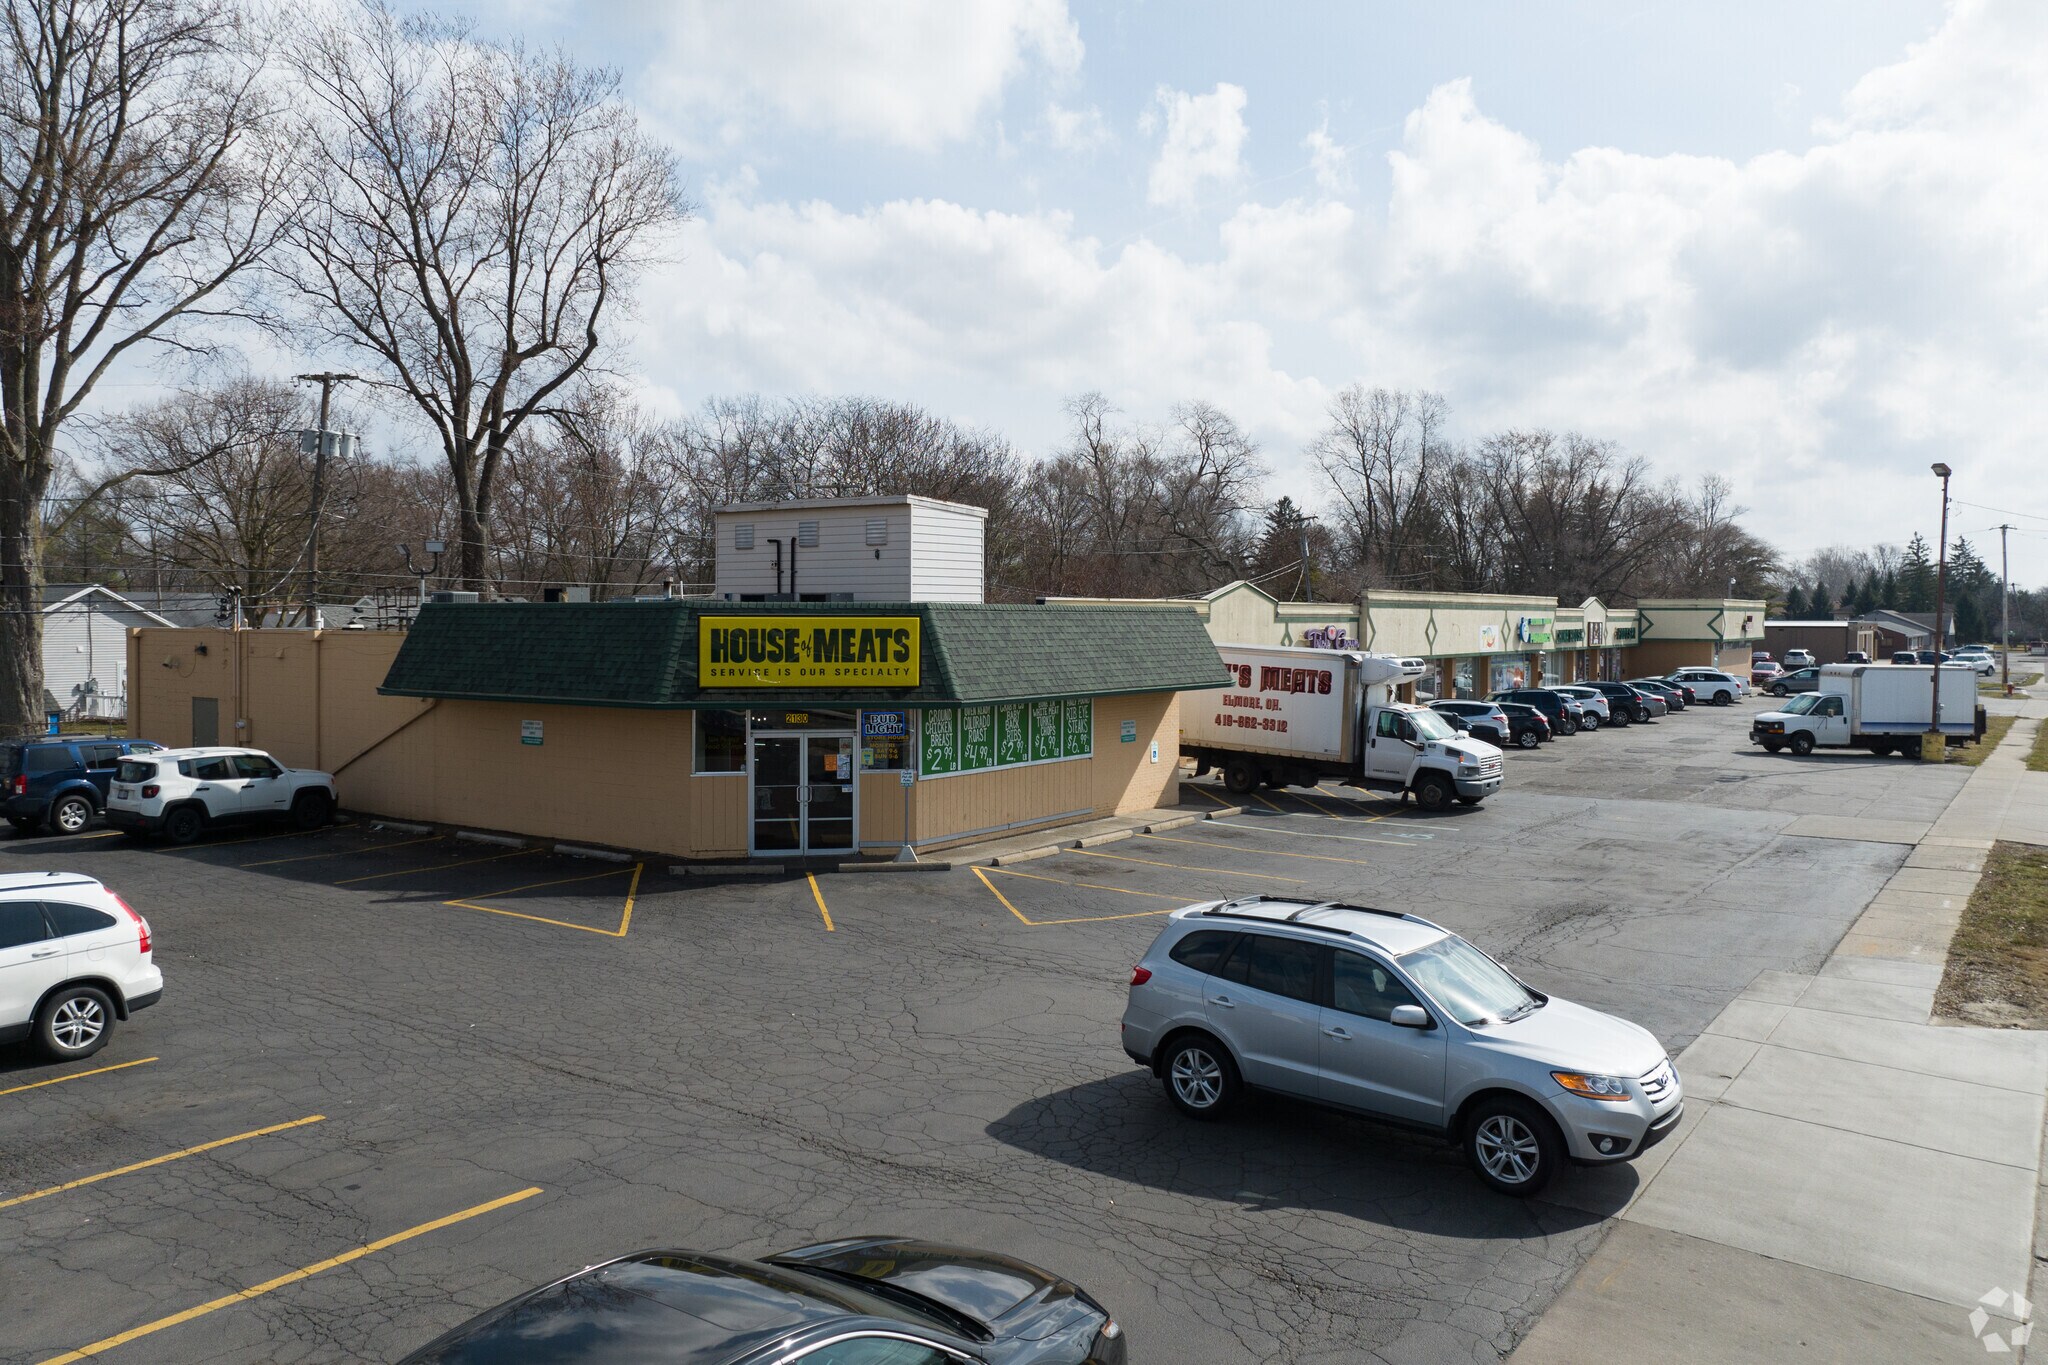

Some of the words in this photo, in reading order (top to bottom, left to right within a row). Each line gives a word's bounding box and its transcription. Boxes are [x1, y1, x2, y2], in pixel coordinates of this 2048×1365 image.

[711, 628, 800, 663] HOUSE
[801, 634, 812, 658] of
[813, 628, 910, 663] MEATS
[711, 668, 769, 676] SERVICE
[778, 668, 791, 676] IS
[800, 668, 826, 676] OUR
[835, 668, 910, 676] SPECIALTY
[1260, 666, 1332, 695] MEATS
[1222, 695, 1263, 710] ELMORE,
[1265, 698, 1282, 711] OH.
[928, 708, 952, 723] GROUND
[1006, 710, 1020, 720] BABY
[1033, 707, 1047, 717] WHITE
[1048, 706, 1059, 715] MEAT
[1066, 707, 1077, 720] RIB
[1079, 705, 1088, 718] EYE
[785, 713, 809, 724] 2130
[870, 714, 897, 725] BUD
[963, 714, 991, 731] COLORADO
[1005, 719, 1020, 731] BACK
[1036, 715, 1056, 728] TURKEY
[1215, 714, 1288, 733] 419-862-3312
[865, 723, 902, 734] LIGHT
[925, 720, 953, 735] CHICKEN
[1040, 726, 1056, 737] CHOPS
[1067, 719, 1088, 734] STEAKS
[930, 733, 953, 747] BREAST
[968, 728, 987, 743] ROAST
[1006, 729, 1021, 742] RIBS
[949, 762, 956, 771] LB
[986, 757, 992, 766] LB
